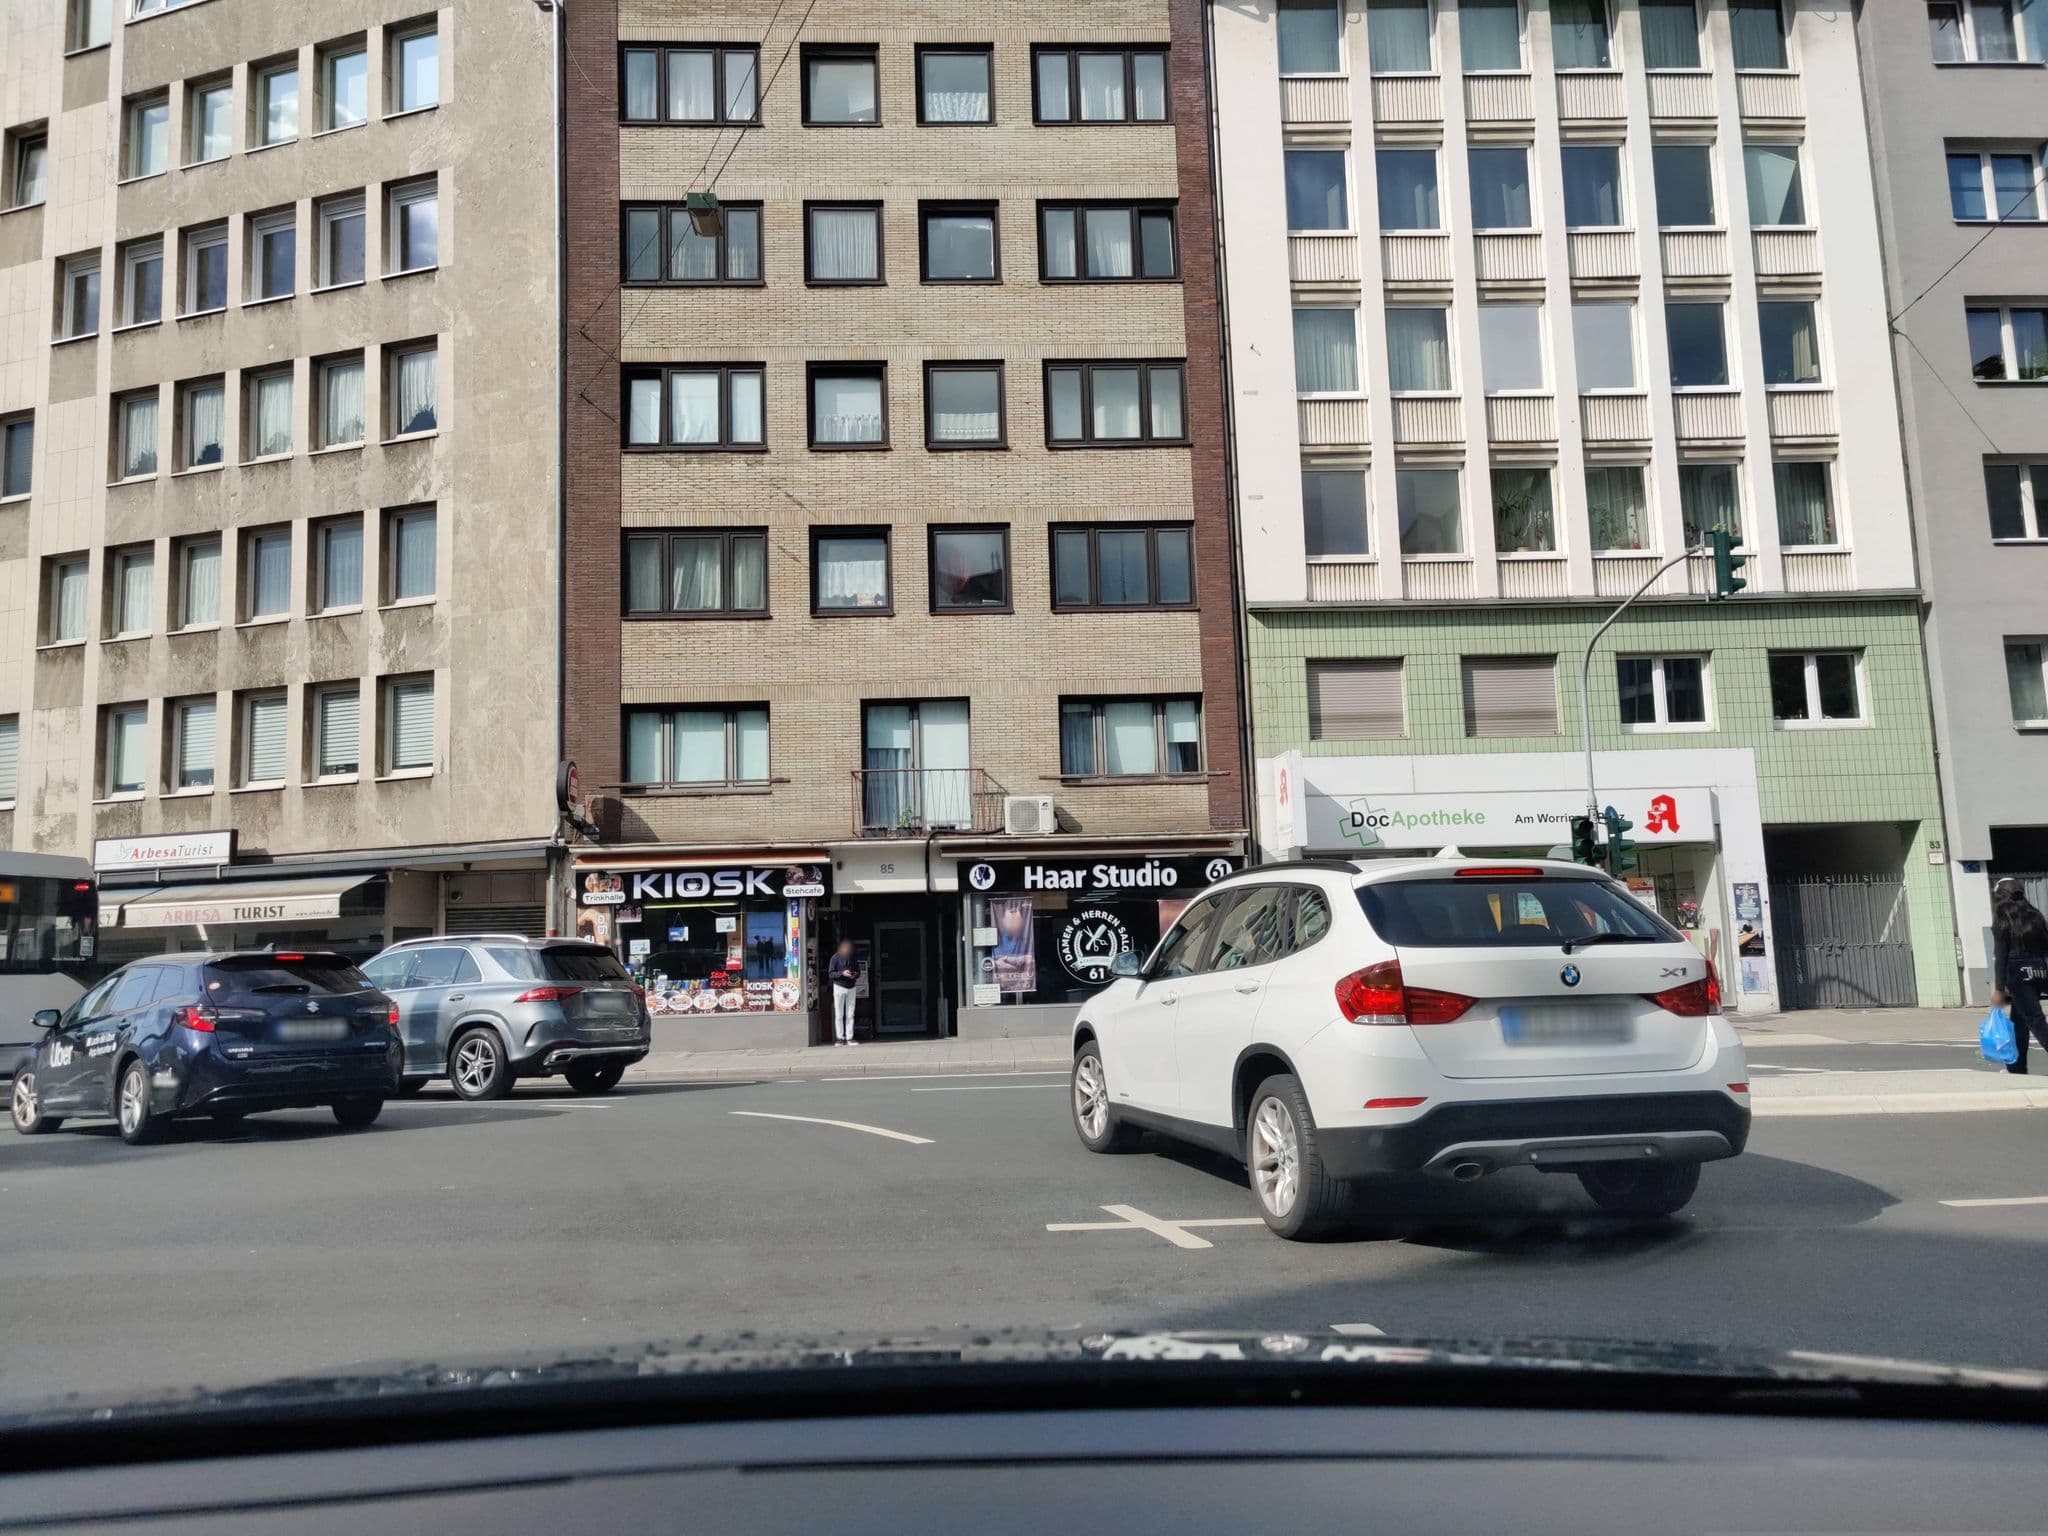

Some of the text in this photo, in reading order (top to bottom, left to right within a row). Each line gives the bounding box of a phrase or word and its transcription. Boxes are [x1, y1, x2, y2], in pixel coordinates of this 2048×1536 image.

[1350, 809, 1486, 830] DocApotheke
[1515, 813, 1577, 824] Am Worrin
[131, 845, 213, 859] ArbesaTurist
[880, 863, 895, 874] 85
[1024, 860, 1178, 889] Haar Studio
[1209, 863, 1228, 879] 61
[633, 870, 777, 900] KIOSK
[163, 908, 221, 922] ARBESA
[232, 905, 286, 919] TURIST
[1062, 910, 1130, 962] DAMEN & HERREN SALO
[1089, 967, 1105, 980] 61
[1659, 967, 1687, 978] X1
[747, 981, 773, 991] KIOSK
[49, 1041, 74, 1068] Uber
